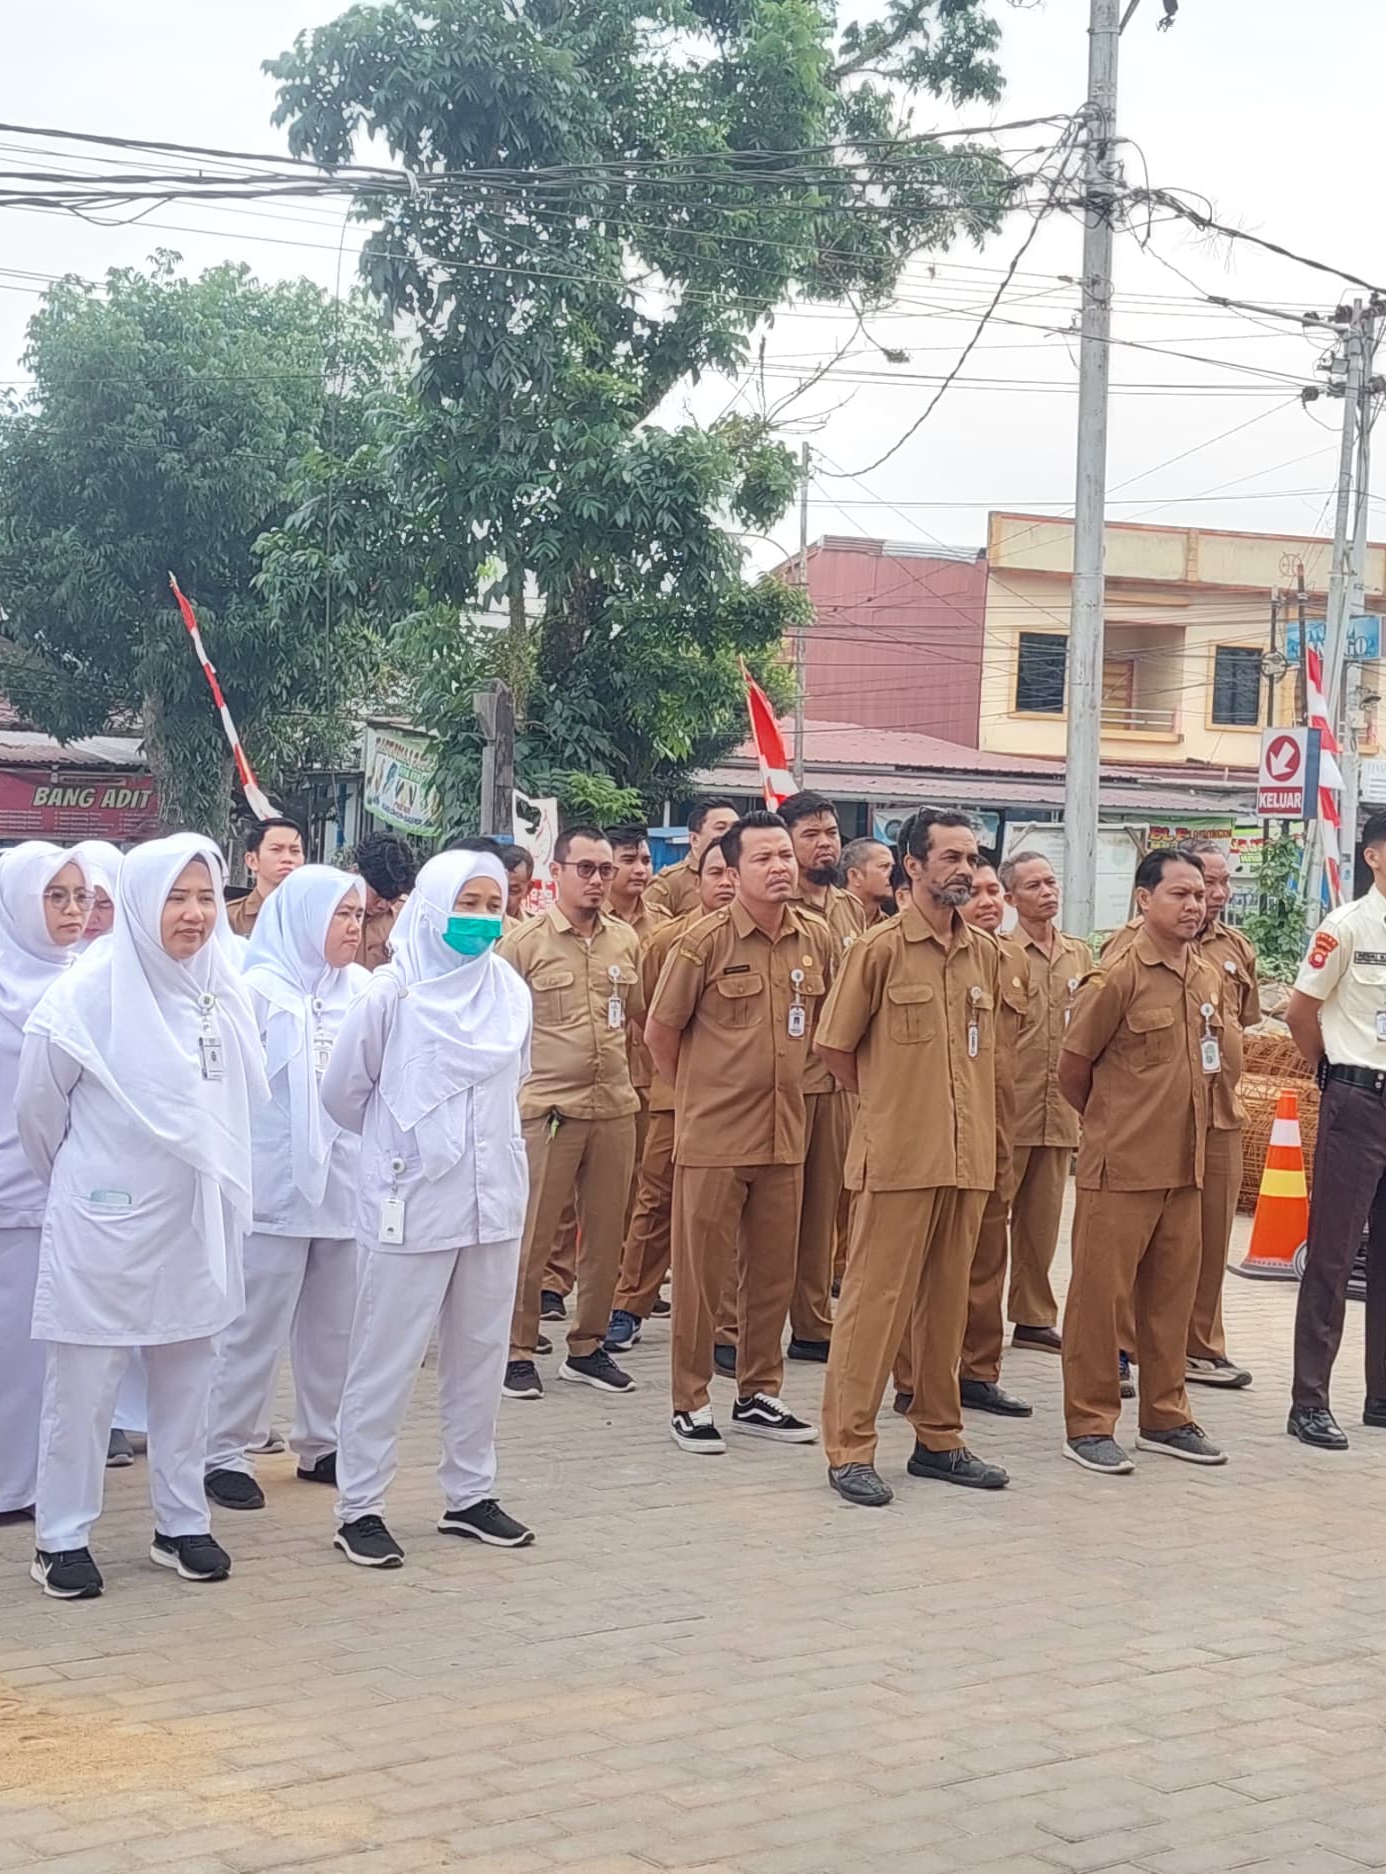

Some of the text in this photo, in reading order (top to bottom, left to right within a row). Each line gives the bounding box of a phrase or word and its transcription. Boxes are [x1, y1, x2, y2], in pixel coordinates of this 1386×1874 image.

[33, 786, 151, 810] BANG ADIT
[1259, 792, 1301, 808] KELUAR
